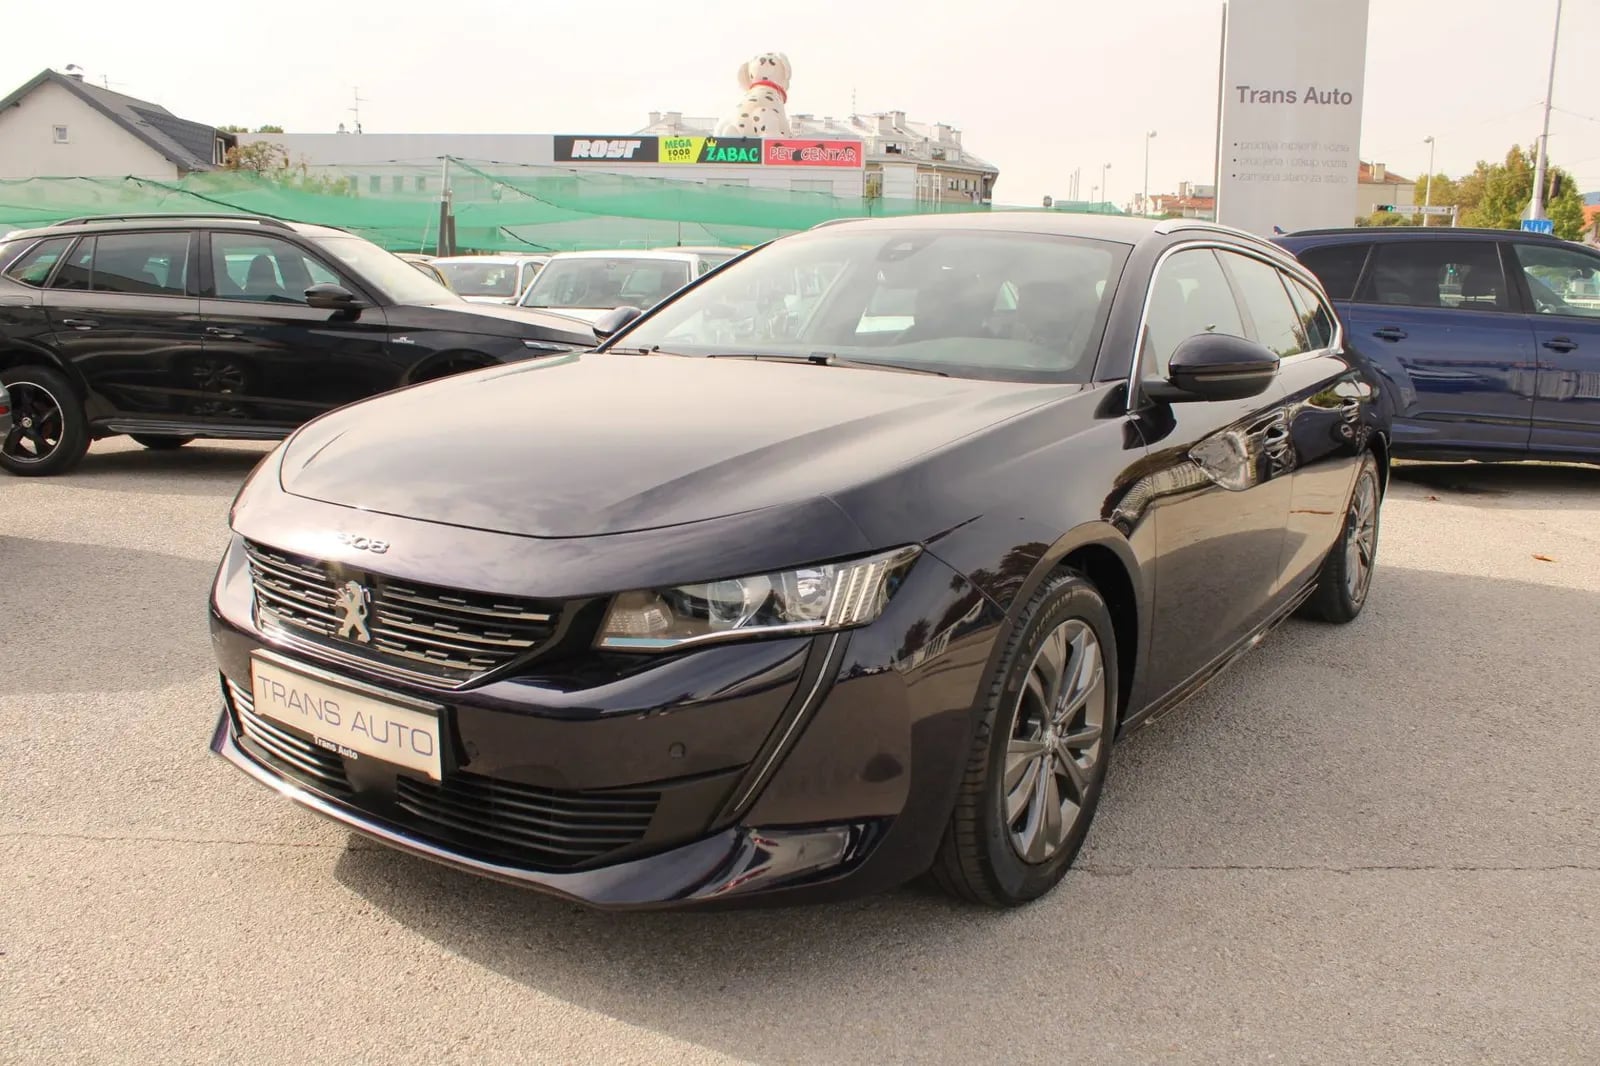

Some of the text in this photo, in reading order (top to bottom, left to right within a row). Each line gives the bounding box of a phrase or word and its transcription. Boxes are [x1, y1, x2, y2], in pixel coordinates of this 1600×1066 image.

[1236, 86, 1353, 105] Trans Auto
[571, 140, 641, 158] ROST
[665, 139, 692, 149] MEGA
[668, 148, 690, 156] FOOD
[769, 146, 857, 162] PET CENTAR
[257, 675, 433, 757] TRANS AUTO
[313, 735, 358, 760] Trans Auto
